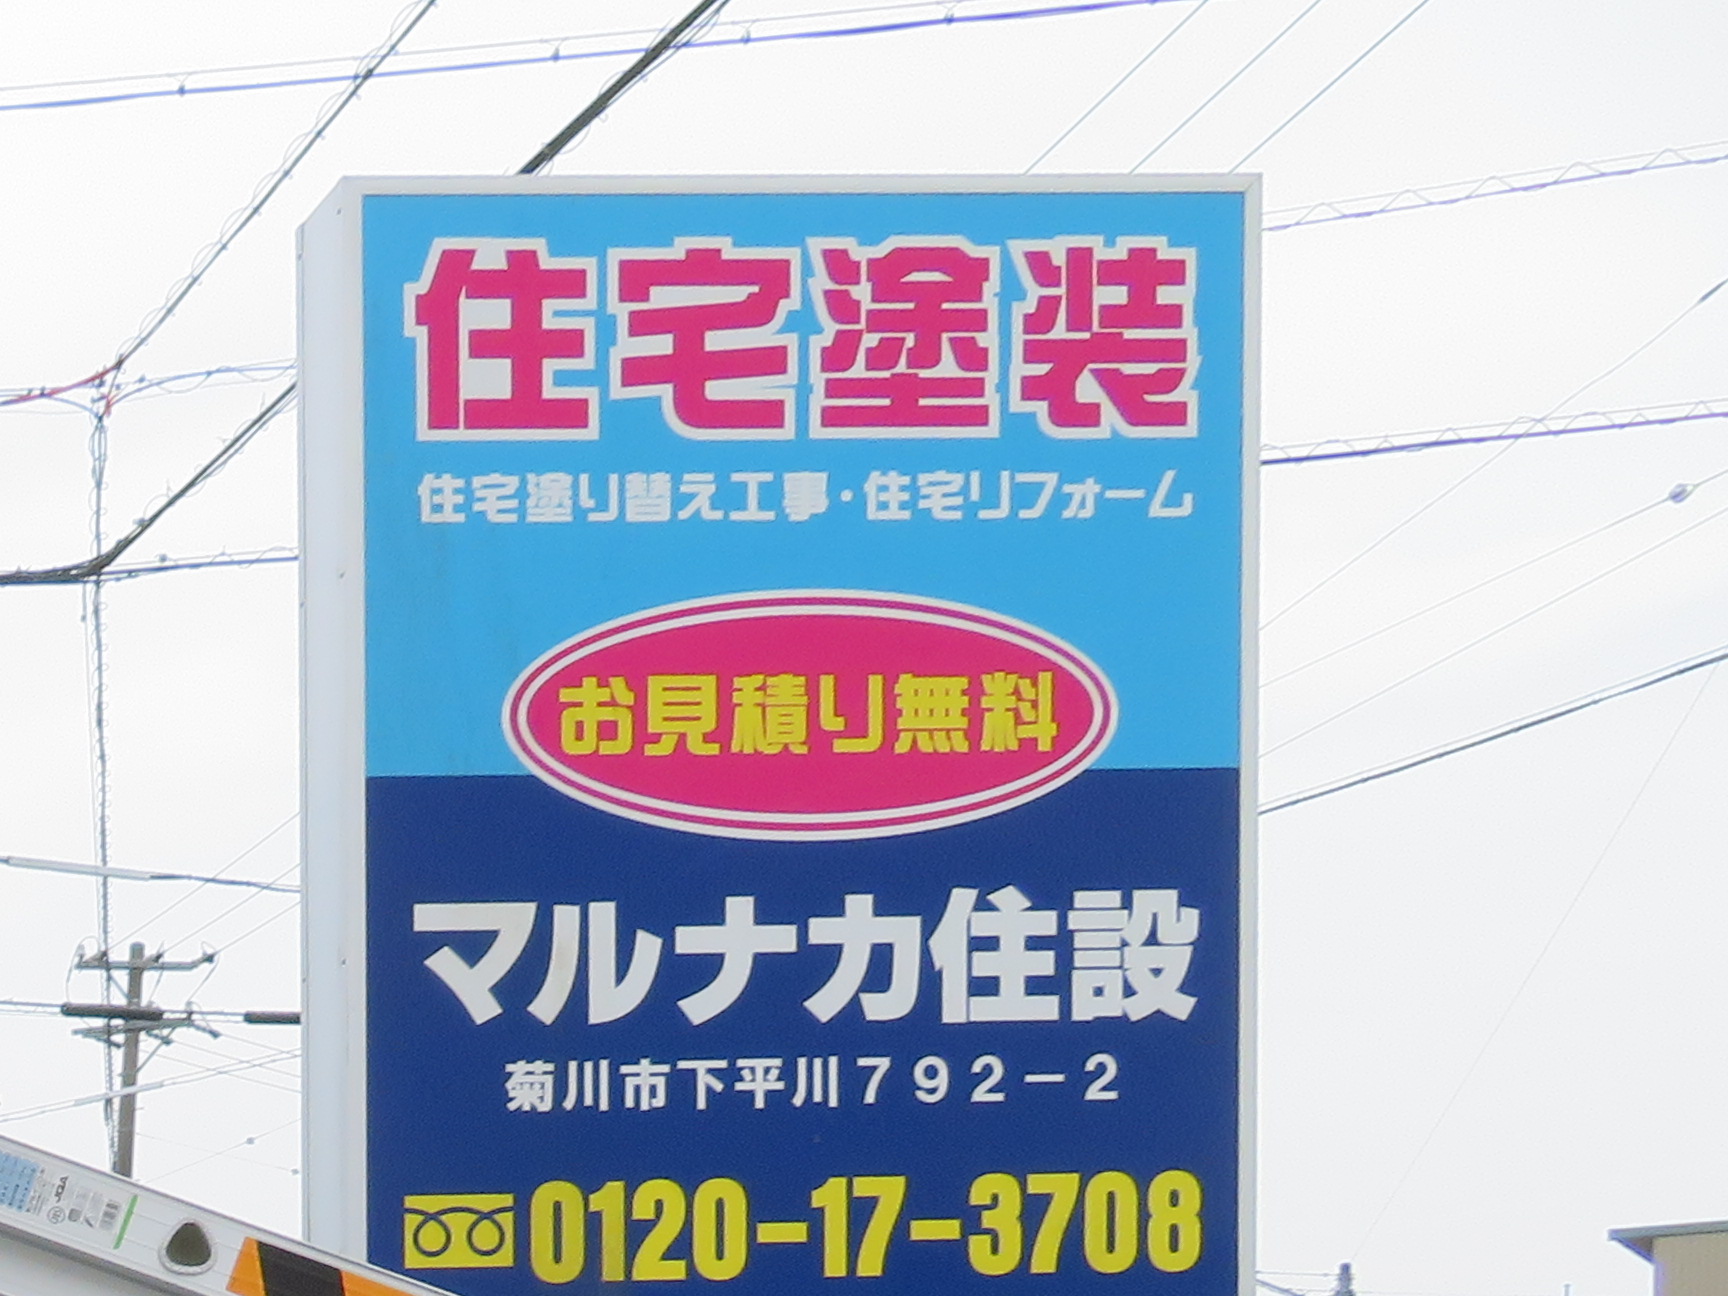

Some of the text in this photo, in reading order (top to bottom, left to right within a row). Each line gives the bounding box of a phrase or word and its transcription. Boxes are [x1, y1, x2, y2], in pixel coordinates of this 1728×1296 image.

[410, 243, 1194, 435] 住宅塗装
[417, 469, 1193, 525] 住宅塗り替え工事・住宅リフォーム
[557, 672, 1059, 756] お見積り無料
[411, 885, 1200, 1026] マルナカ住設
[530, 1170, 1202, 1284] 0120-17-3708
